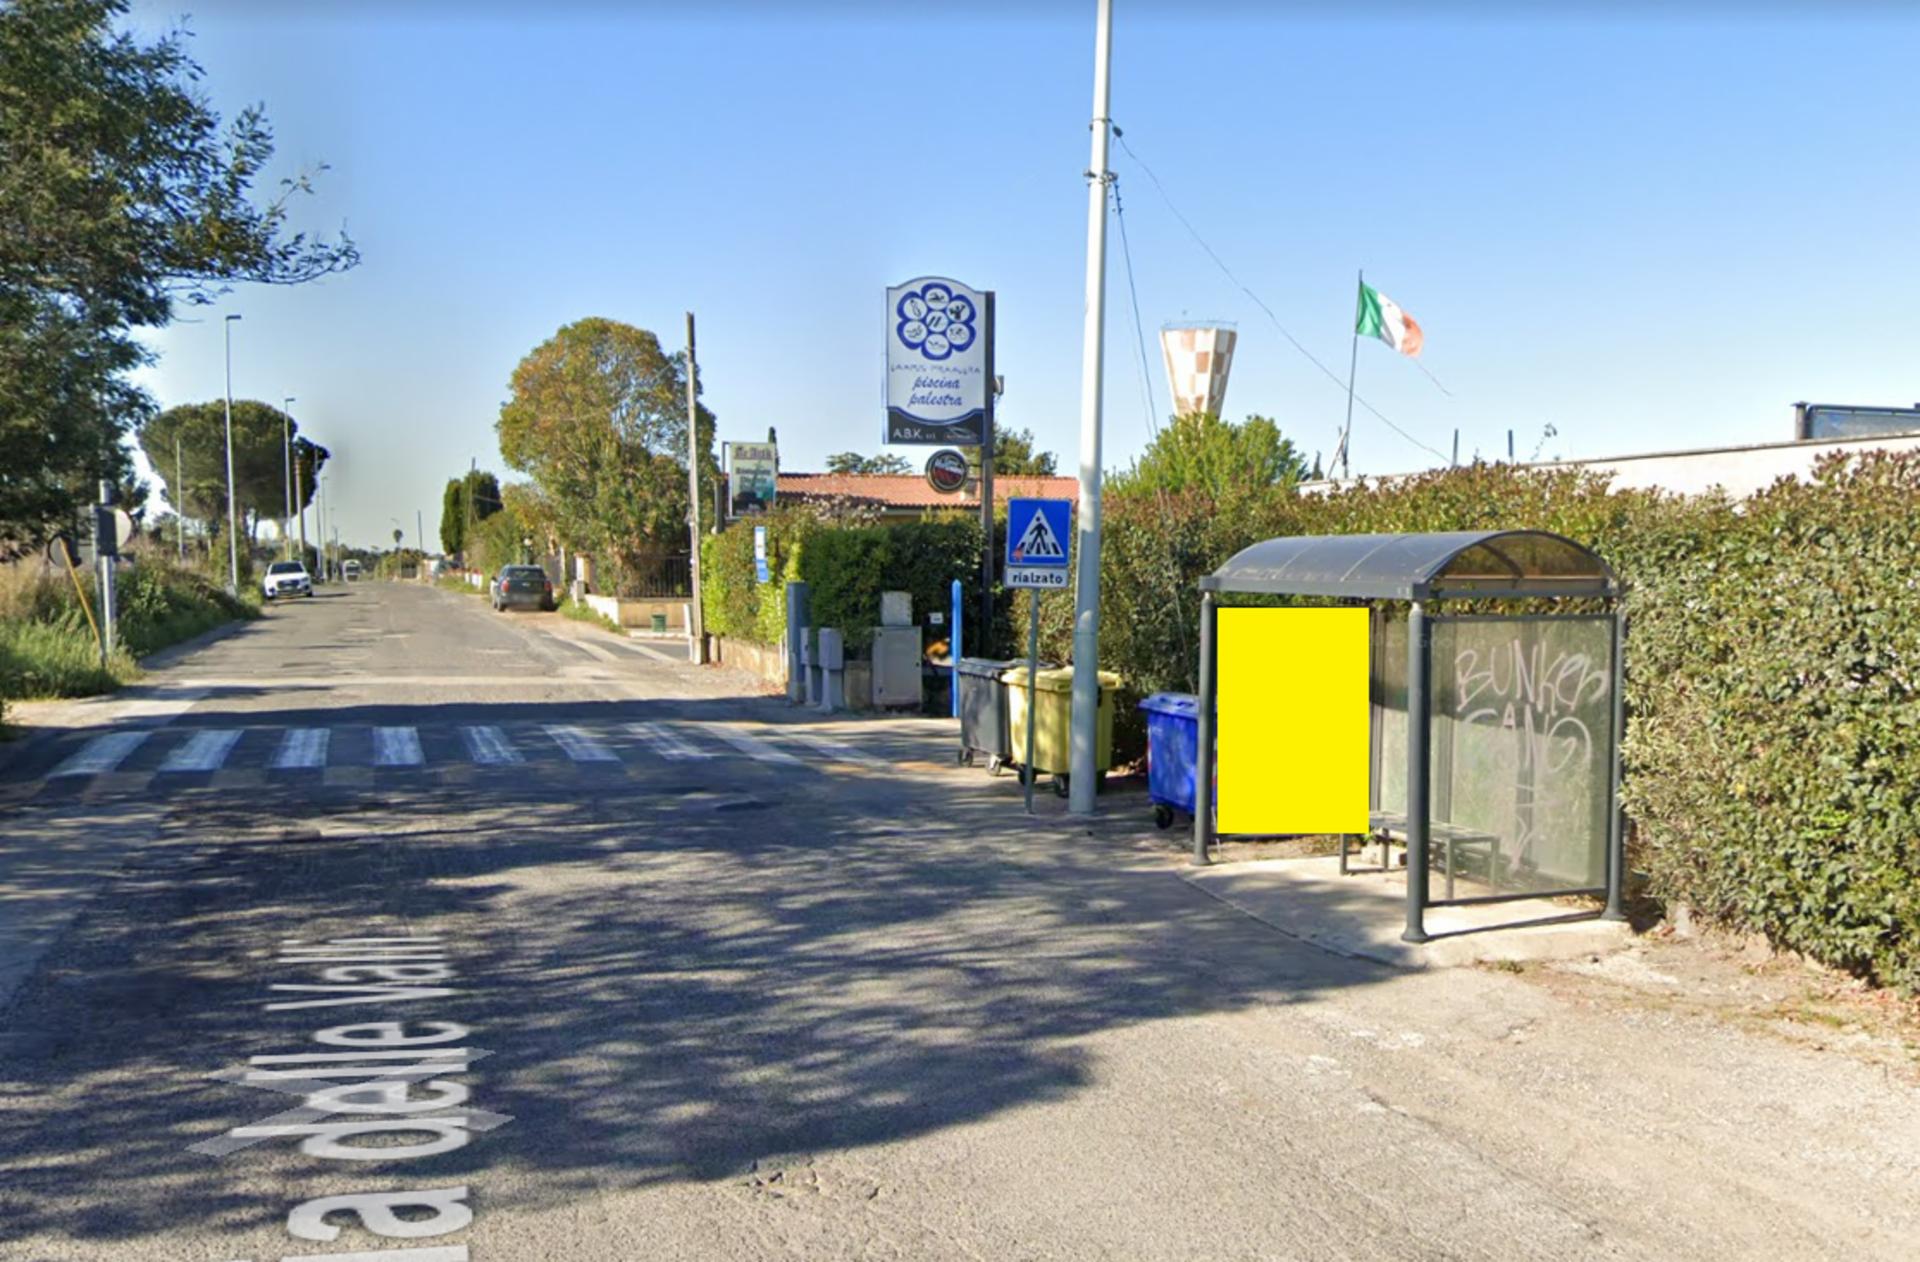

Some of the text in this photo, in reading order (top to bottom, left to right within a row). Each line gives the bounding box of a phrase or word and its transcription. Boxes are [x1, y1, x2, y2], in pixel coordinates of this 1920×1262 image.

[912, 377, 961, 391] piscina
[907, 391, 963, 408] palestra
[1013, 572, 1063, 584] rialzato
